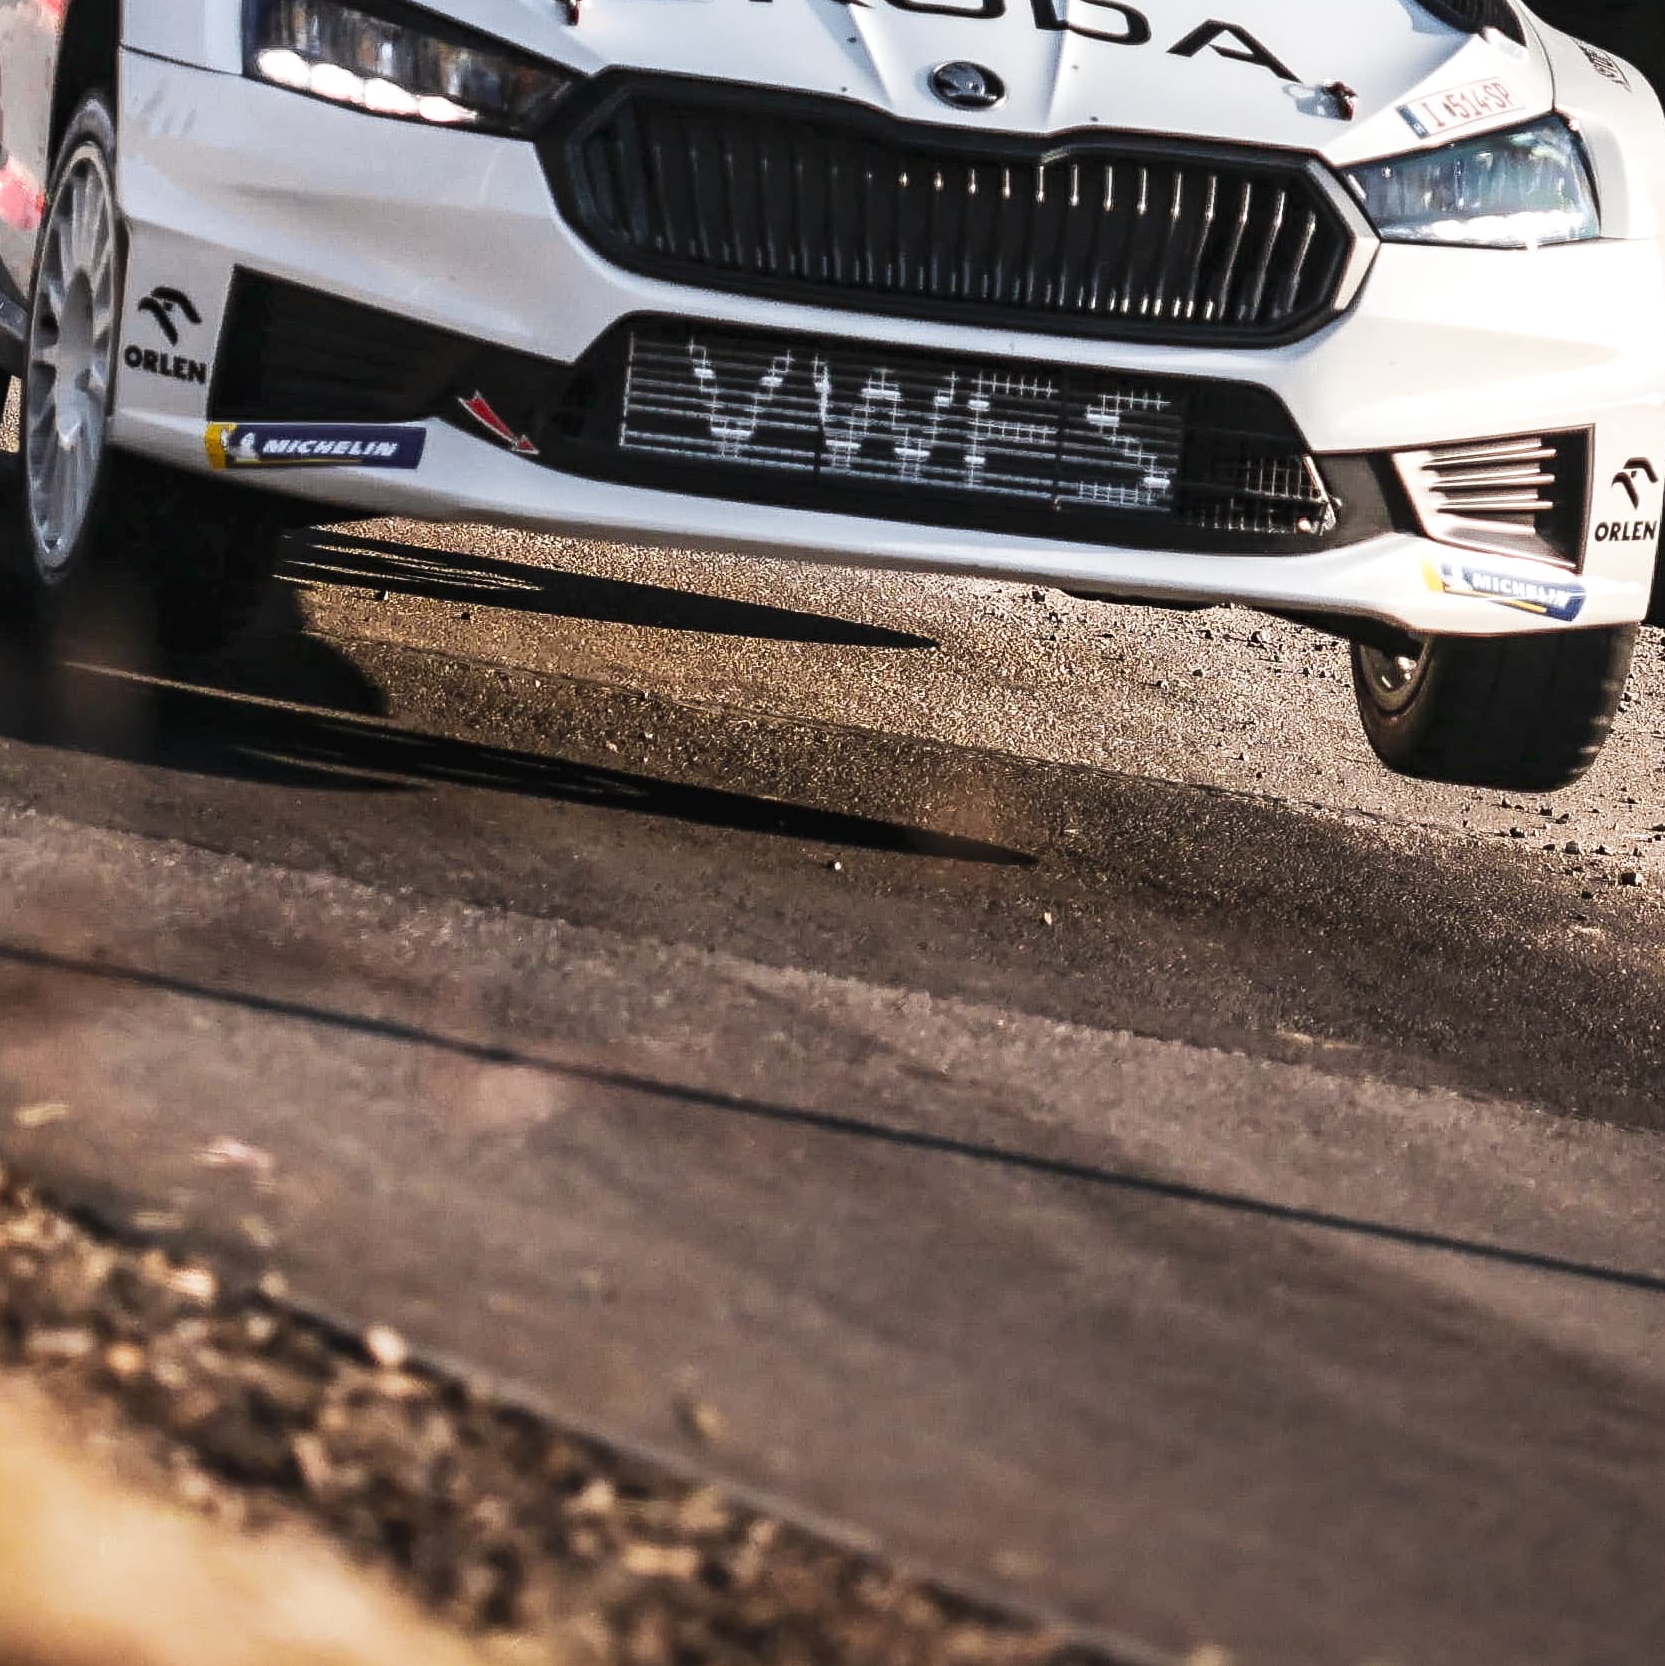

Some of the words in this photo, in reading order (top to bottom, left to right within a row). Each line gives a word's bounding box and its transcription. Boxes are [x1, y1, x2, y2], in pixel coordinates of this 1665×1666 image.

[124, 345, 207, 384] ORLEN
[687, 337, 1172, 506] VWFS
[262, 438, 400, 457] MICHELIN
[1594, 520, 1658, 542] ORLEN
[1471, 571, 1572, 609] MICHELIN
